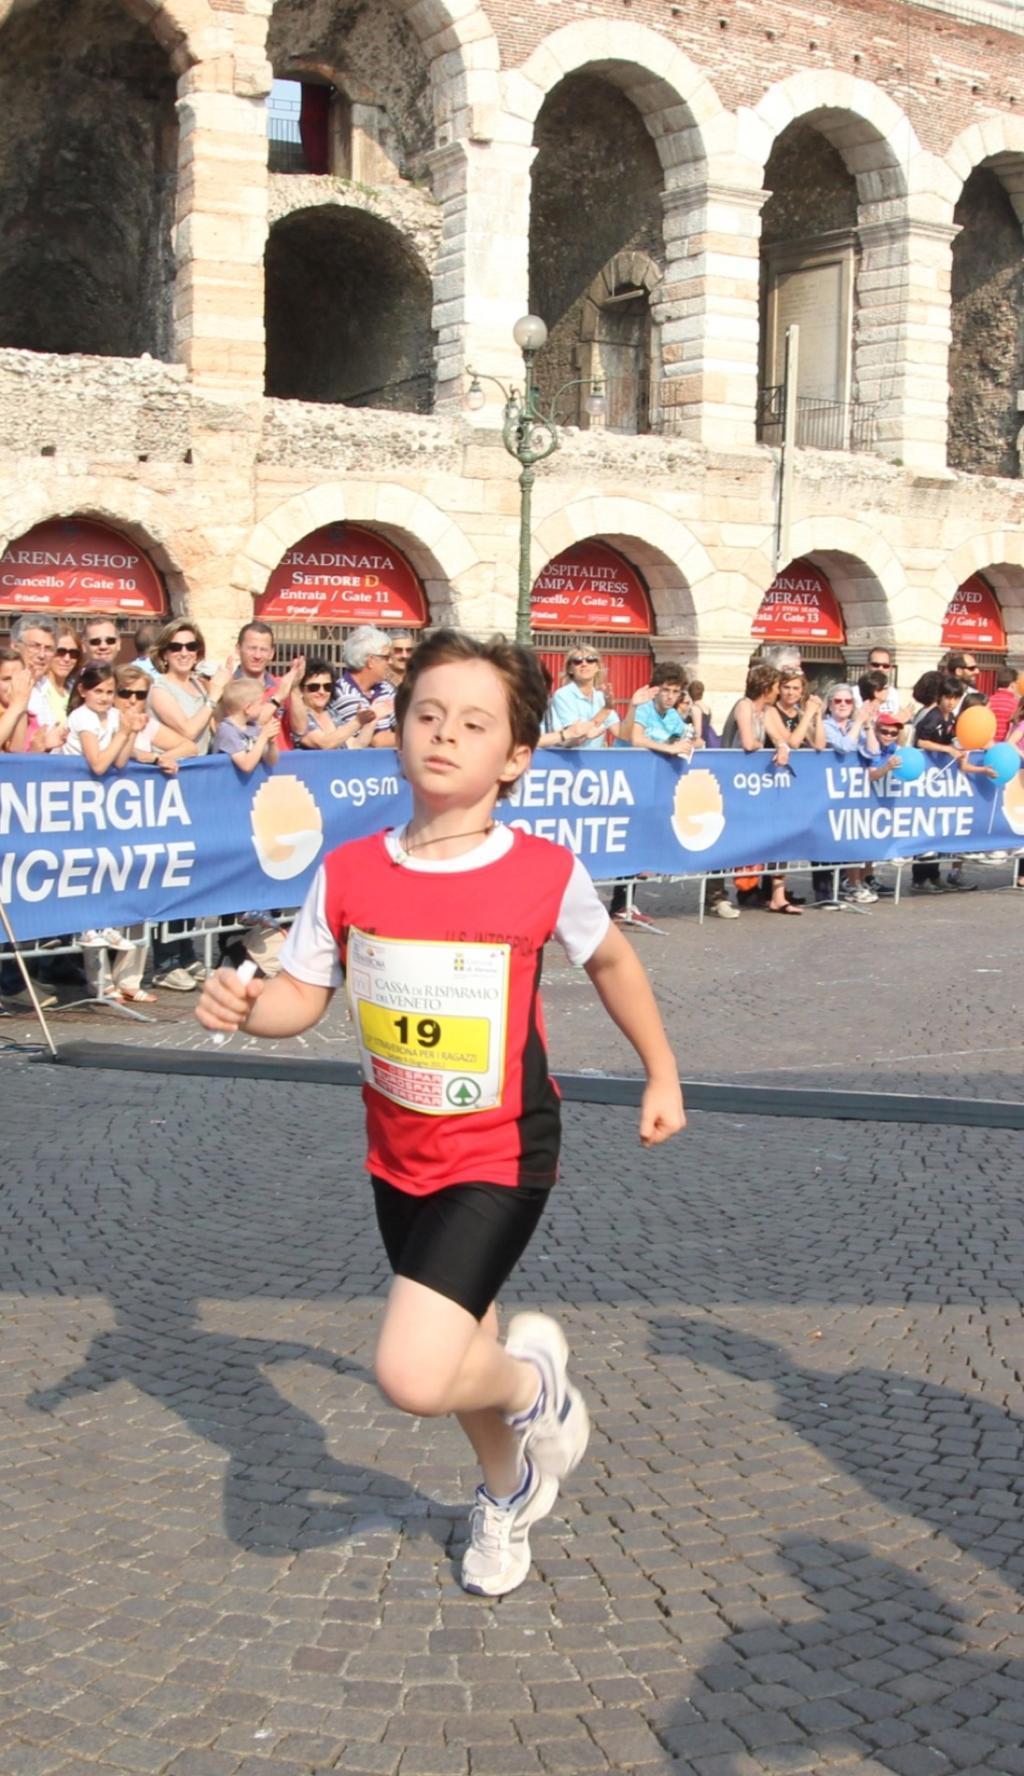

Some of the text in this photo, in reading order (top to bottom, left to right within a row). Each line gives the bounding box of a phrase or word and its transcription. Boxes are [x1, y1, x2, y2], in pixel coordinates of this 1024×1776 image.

[1, 552, 139, 569] ARENA SHOP
[280, 552, 395, 570] GRADINATA
[2, 575, 136, 590] Cancello / Gate 10
[292, 571, 380, 587] SETTORE D
[535, 578, 629, 594] AMPA / PRESS
[280, 589, 389, 603] Entrata / Gate 11
[573, 596, 580, 606] /
[582, 596, 608, 607] Gate
[610, 597, 624, 608] 12
[775, 612, 781, 622] /
[783, 613, 805, 623] Gate
[807, 613, 820, 624] 13
[957, 616, 977, 626] Gate
[331, 775, 399, 806] agsm
[734, 773, 791, 796] agsm
[0, 779, 192, 834] NERGIA
[828, 806, 974, 841] VINCENTE
[375, 978, 409, 995] CASSA
[424, 984, 499, 1001] RISPARMIO
[388, 995, 442, 1011] VENETO
[394, 1016, 441, 1048] 19
